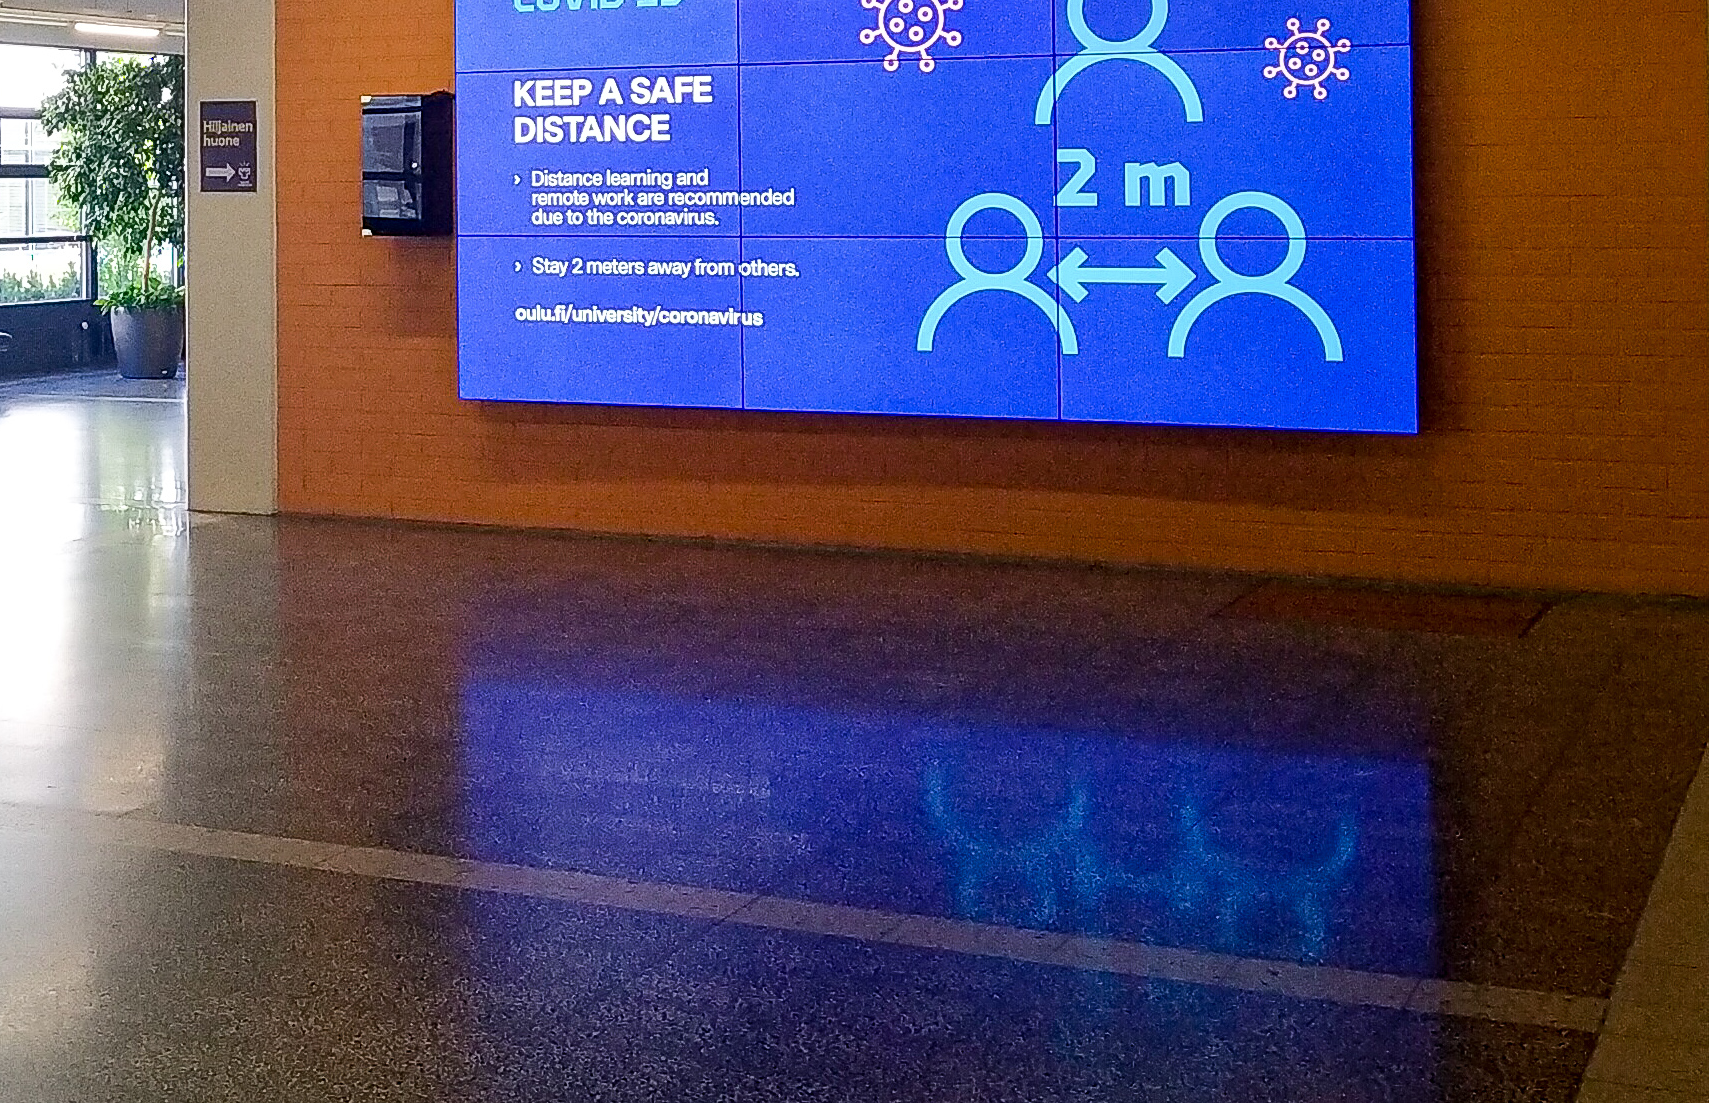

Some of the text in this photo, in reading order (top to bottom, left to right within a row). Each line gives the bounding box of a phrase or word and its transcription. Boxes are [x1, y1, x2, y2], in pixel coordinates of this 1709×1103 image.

[514, 75, 714, 108] KEEP A SAFE
[514, 113, 672, 144] DISTANCE
[203, 135, 240, 147] huone
[531, 168, 709, 189] Distance learning and
[1054, 147, 1193, 208] 2 m
[531, 187, 795, 206] remote work are recommended
[531, 209, 720, 226] due to the coronavirus.
[531, 257, 800, 280] Stay 2 meters away from others.
[515, 304, 764, 327] oulu.fi/university/coronavirus
